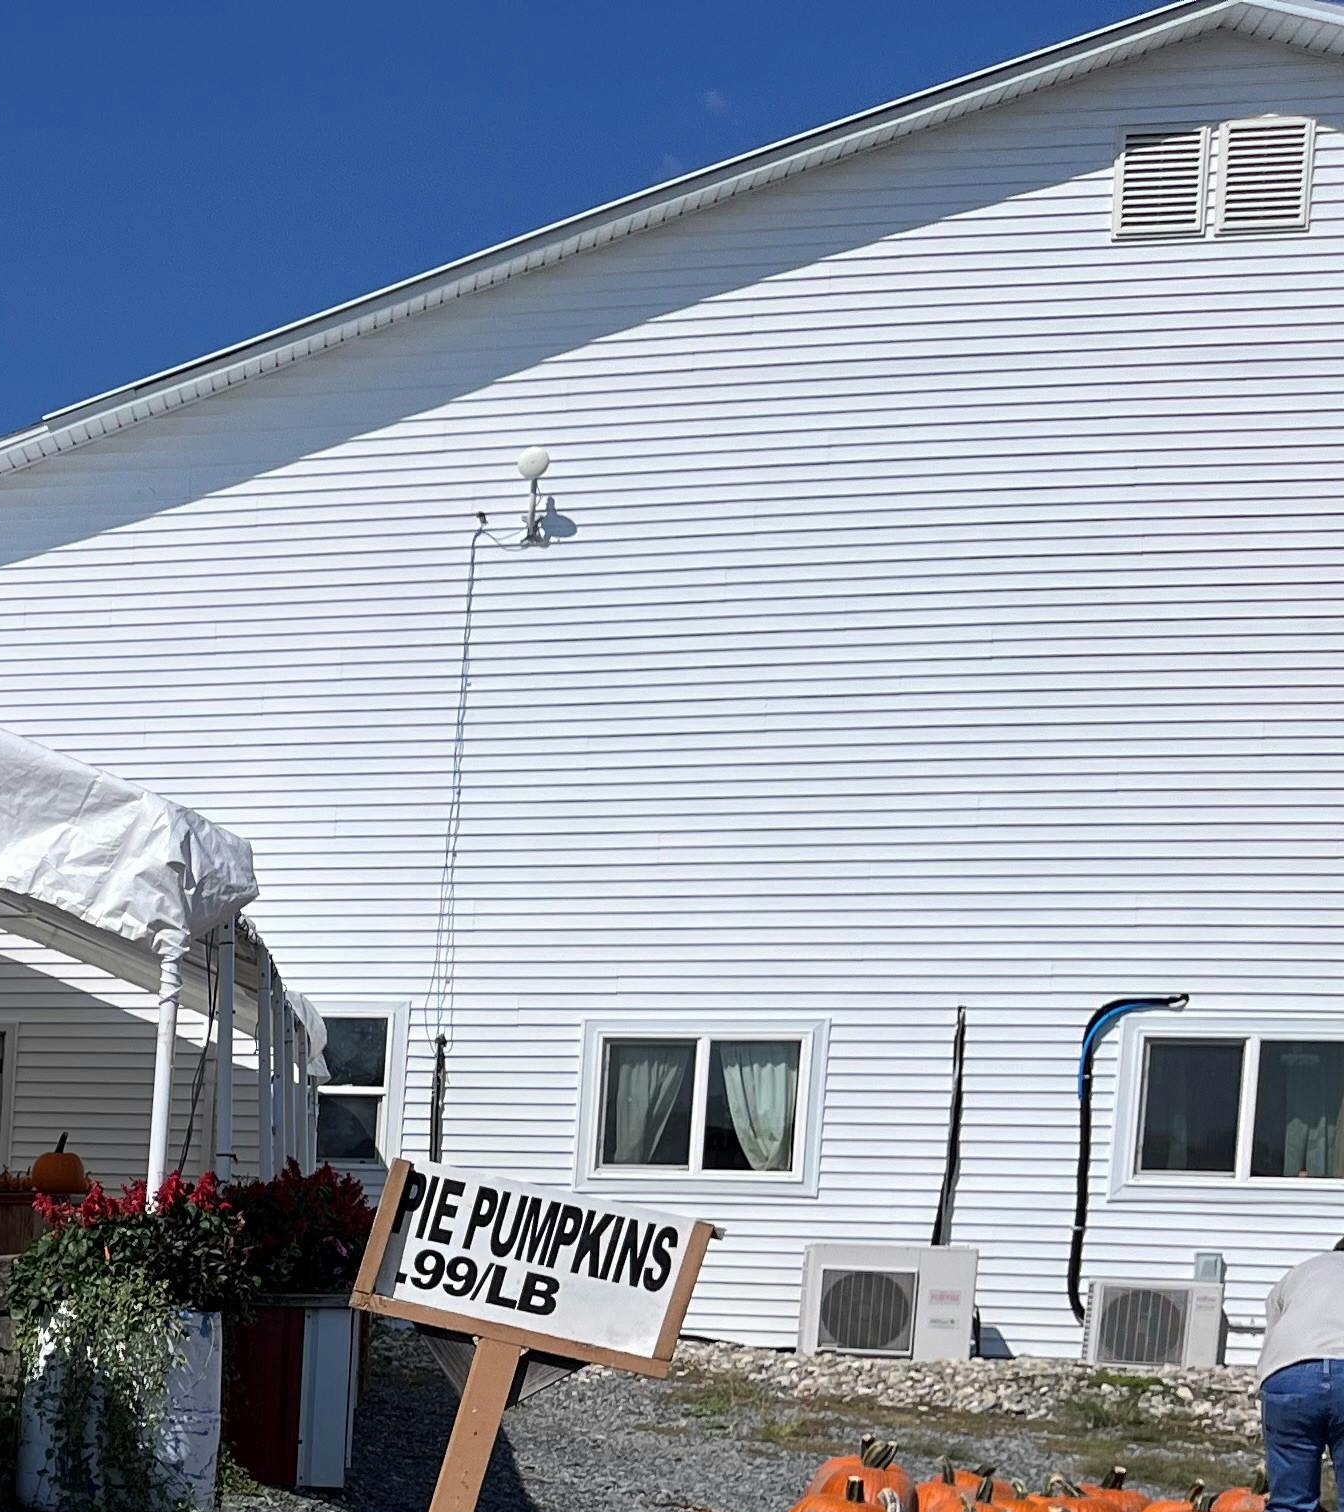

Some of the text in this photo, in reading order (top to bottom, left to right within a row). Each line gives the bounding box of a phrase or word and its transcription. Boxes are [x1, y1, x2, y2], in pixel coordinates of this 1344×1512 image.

[391, 1170, 679, 1292] PIE PUMPKINS
[394, 1249, 561, 1316] .99/LB
